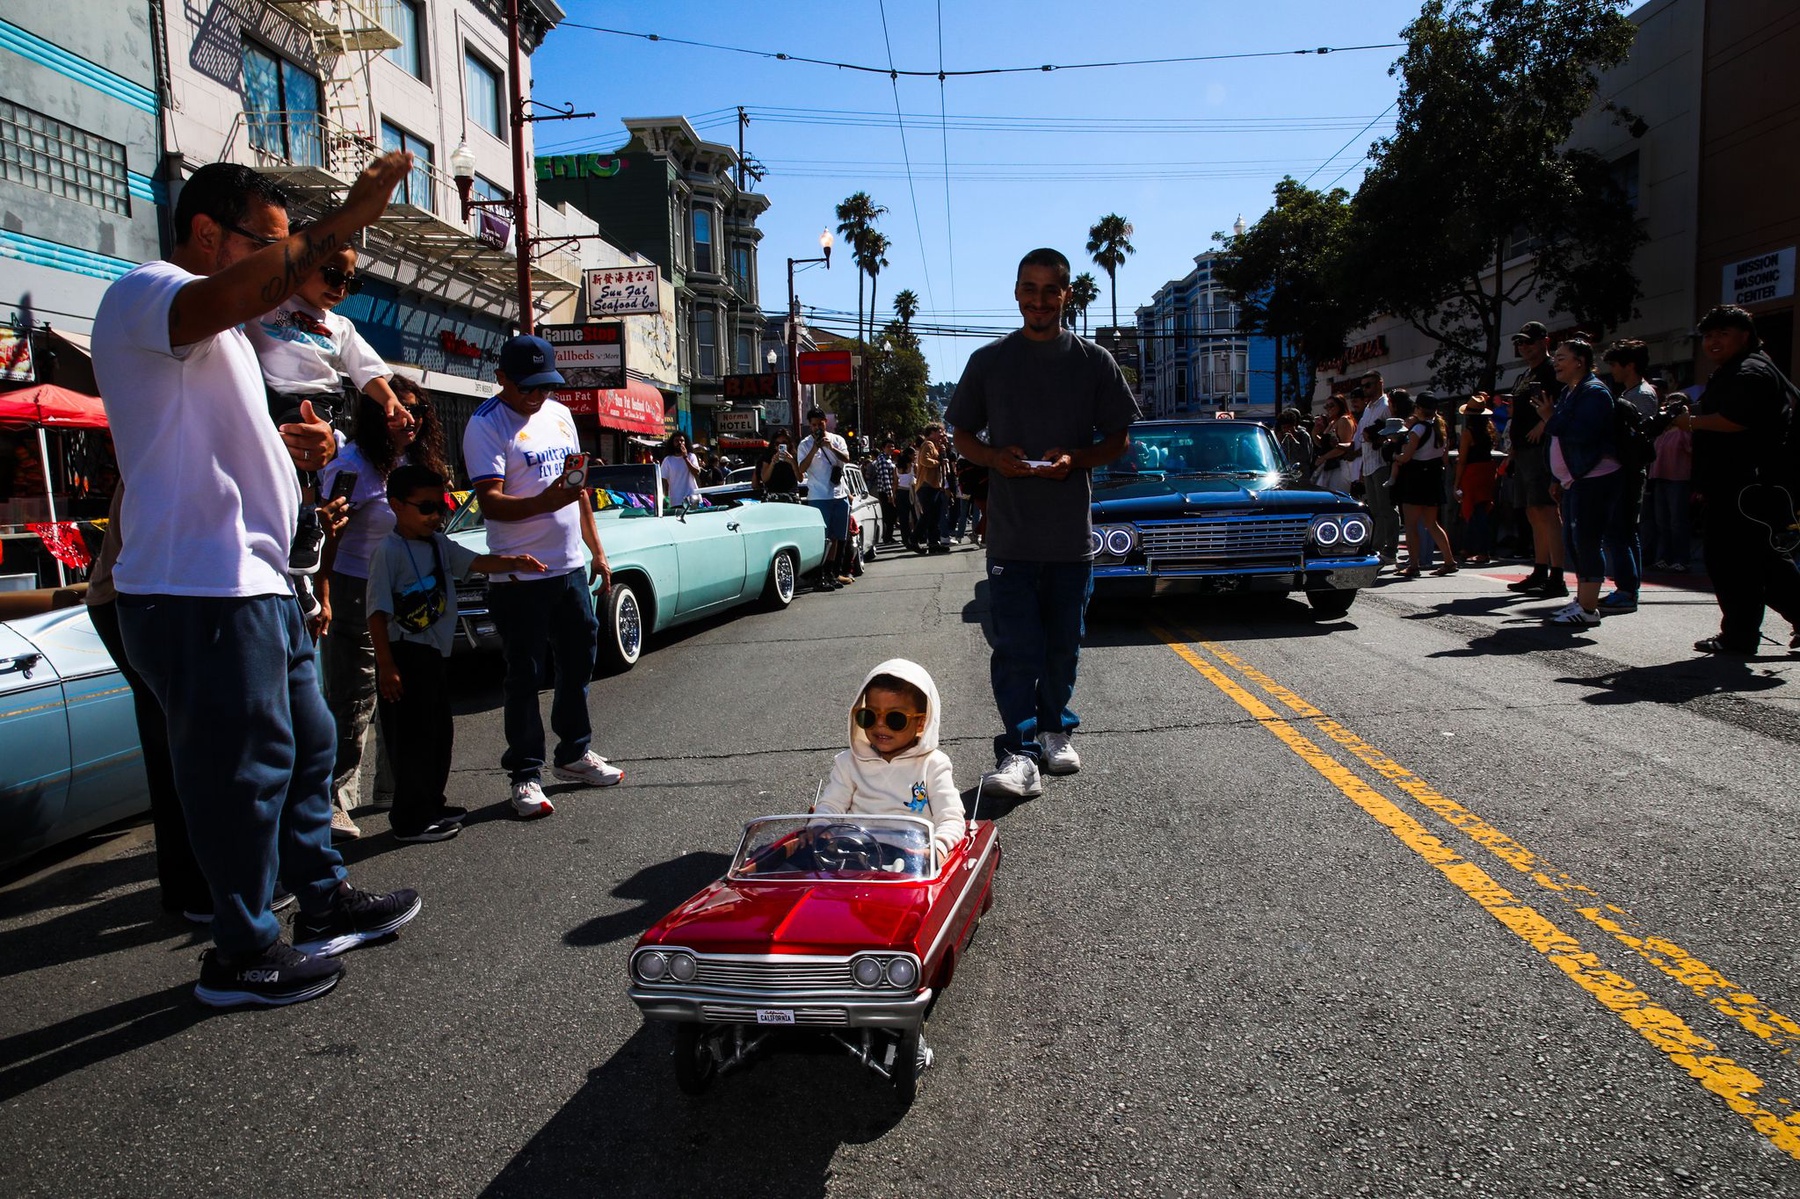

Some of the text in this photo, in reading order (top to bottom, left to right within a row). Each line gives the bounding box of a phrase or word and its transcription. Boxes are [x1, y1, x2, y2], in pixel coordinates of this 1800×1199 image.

[1736, 253, 1779, 276] MISSION
[1734, 269, 1780, 291] MASONIC
[600, 285, 648, 299] Sun Fat
[1736, 285, 1776, 304] CENTER
[592, 295, 658, 312] Seafood Co.
[541, 326, 617, 343] GameStop
[725, 375, 775, 398] BAR
[575, 391, 591, 401] Fat
[720, 421, 753, 430] HOTEL
[723, 413, 749, 421] Norma
[523, 446, 575, 468] Emirat
[539, 464, 554, 478] FLY
[236, 969, 280, 983] HOKA
